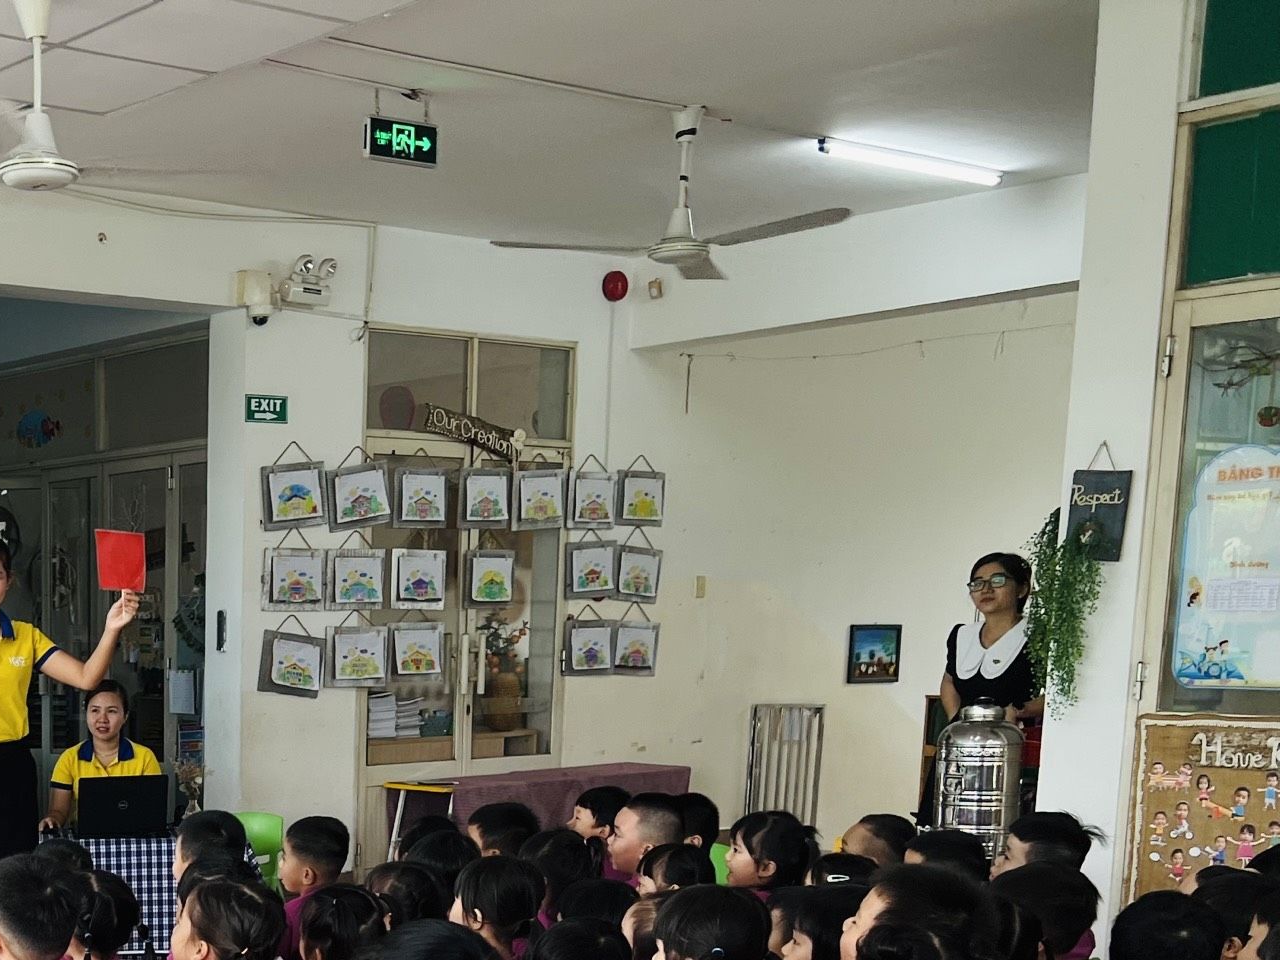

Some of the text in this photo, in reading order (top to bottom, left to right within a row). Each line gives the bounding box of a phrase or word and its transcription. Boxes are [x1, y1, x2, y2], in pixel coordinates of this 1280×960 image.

[251, 398, 282, 411] EXIT
[433, 408, 512, 455] Our Creation
[1072, 484, 1124, 512] Respect
[1191, 733, 1267, 768] Home
